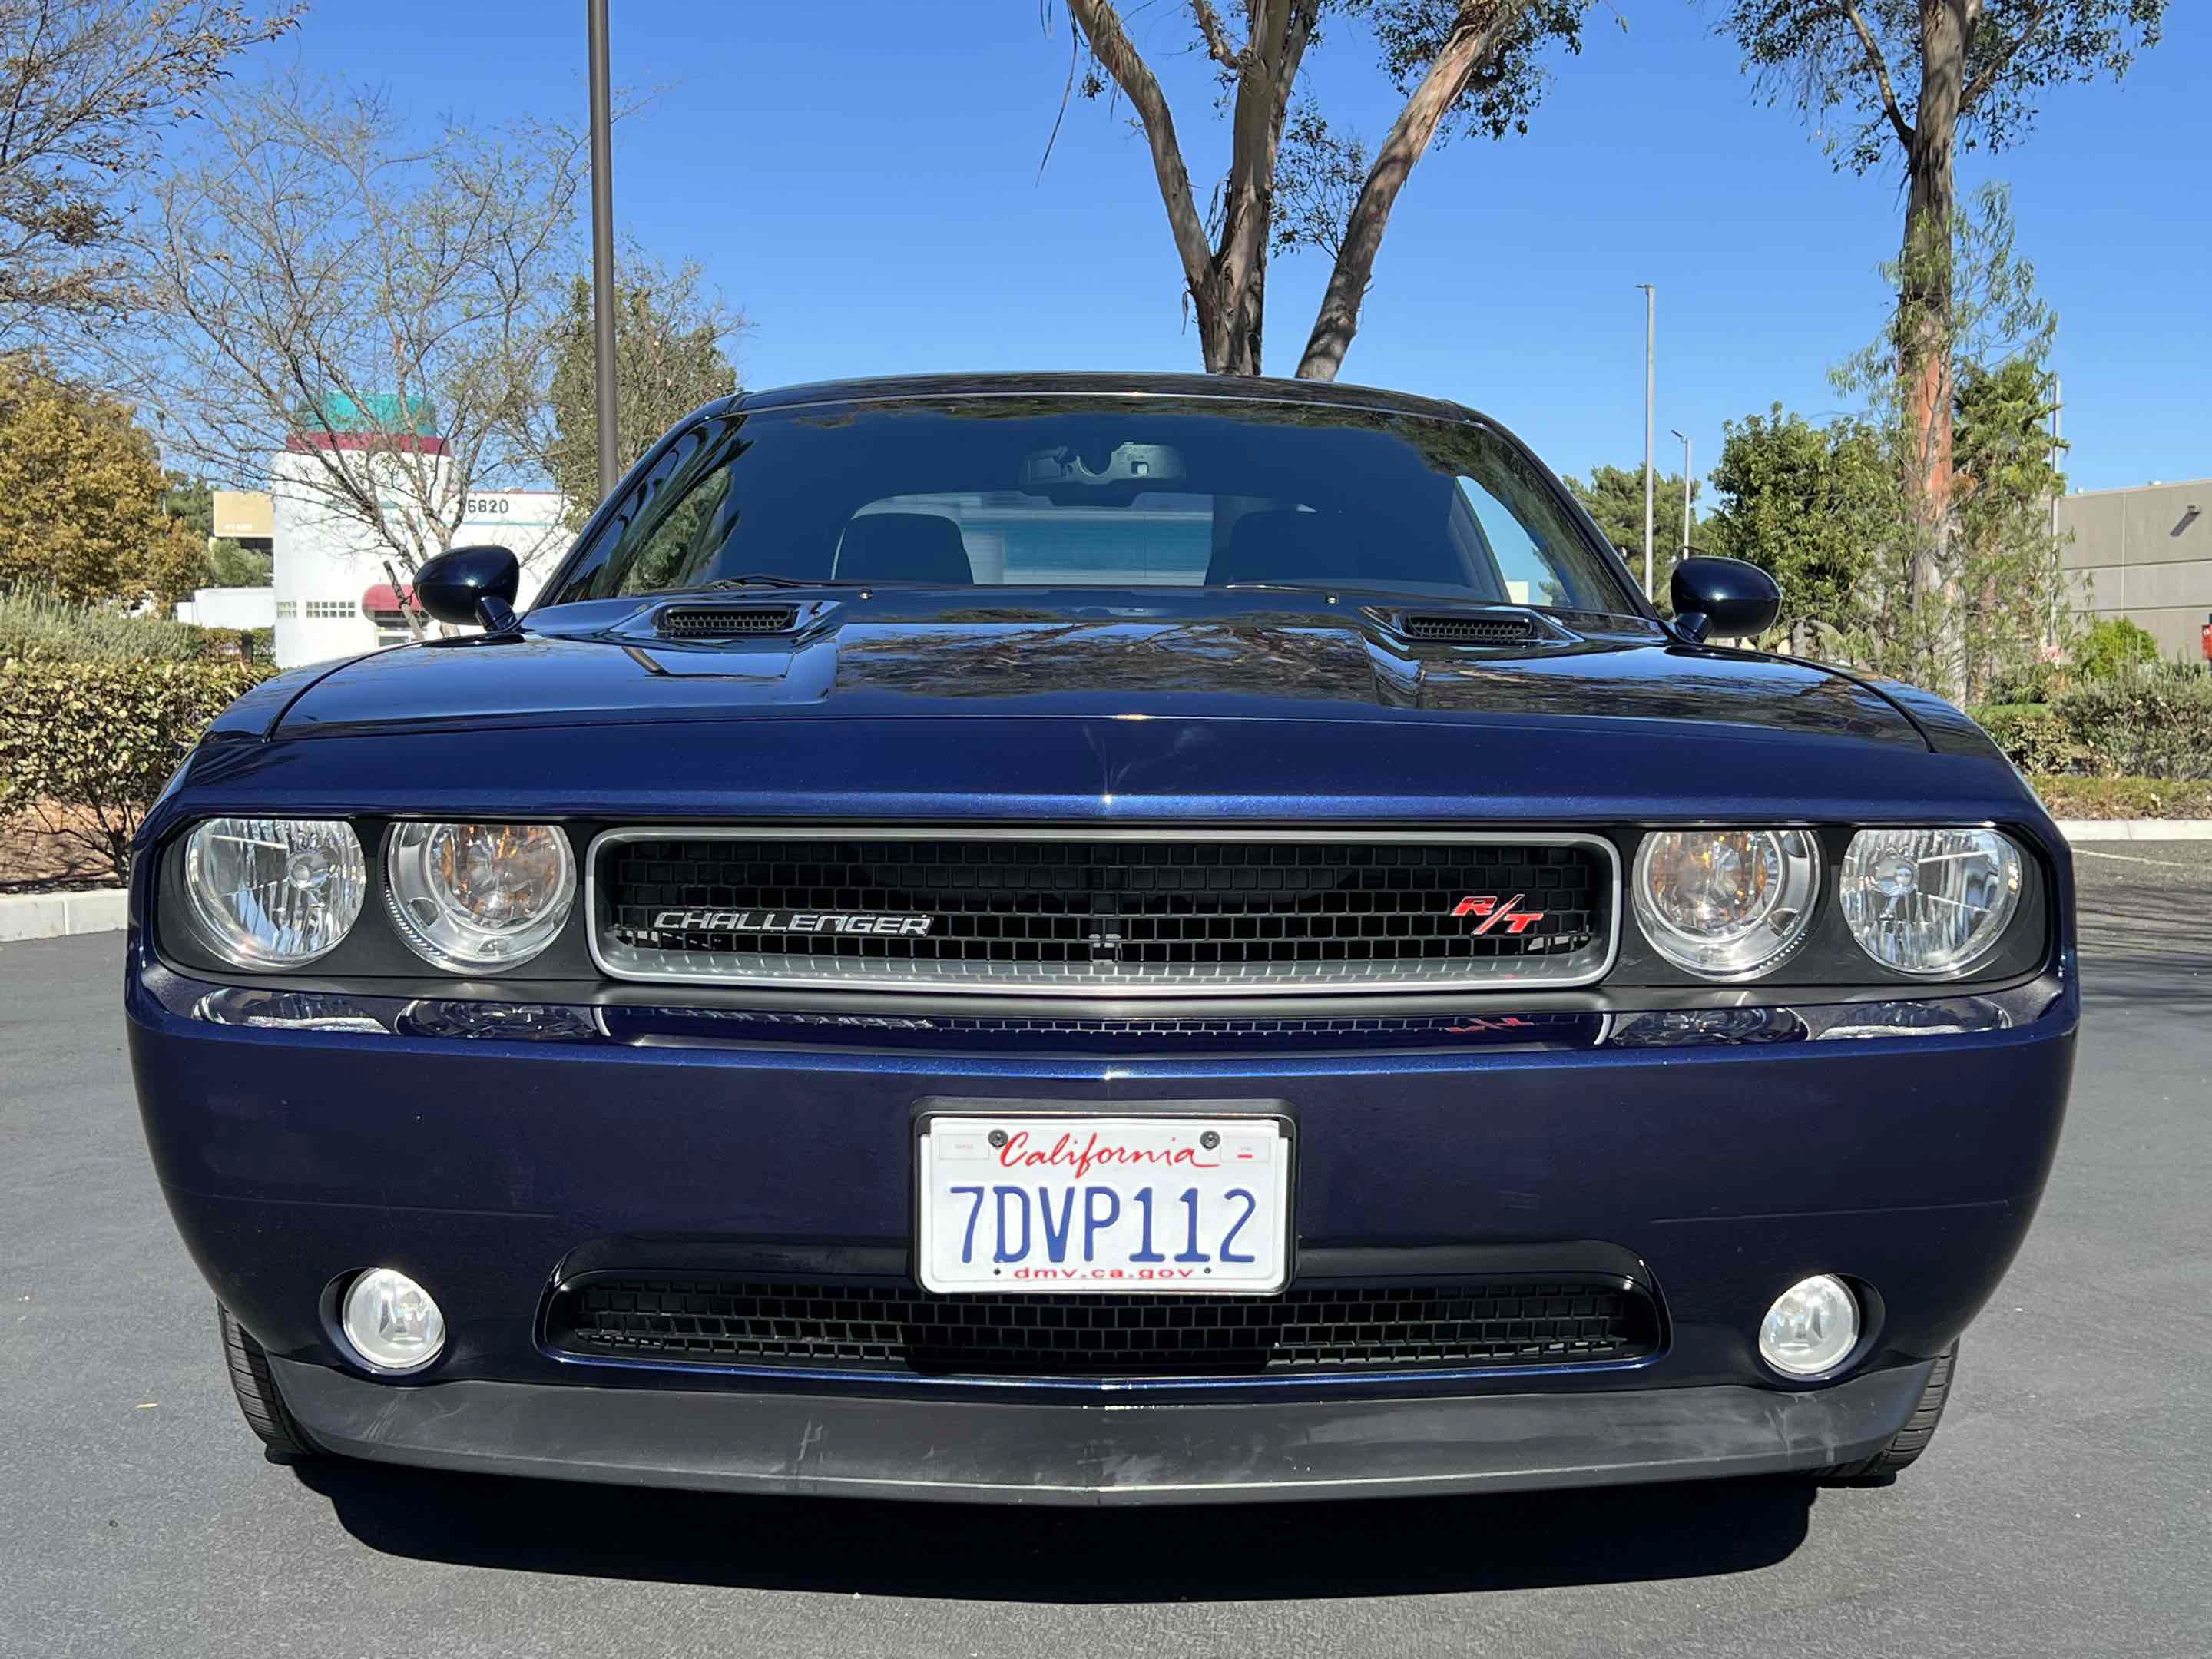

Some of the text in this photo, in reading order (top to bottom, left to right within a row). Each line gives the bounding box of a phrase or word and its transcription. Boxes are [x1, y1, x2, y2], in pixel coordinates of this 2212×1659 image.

[654, 909, 935, 937] CHALLENGER
[1450, 893, 1545, 936] R/T
[998, 1131, 1220, 1179] California
[949, 1186, 1257, 1264] 7DVP112
[1013, 1267, 1194, 1280] dmv.ca.gov
